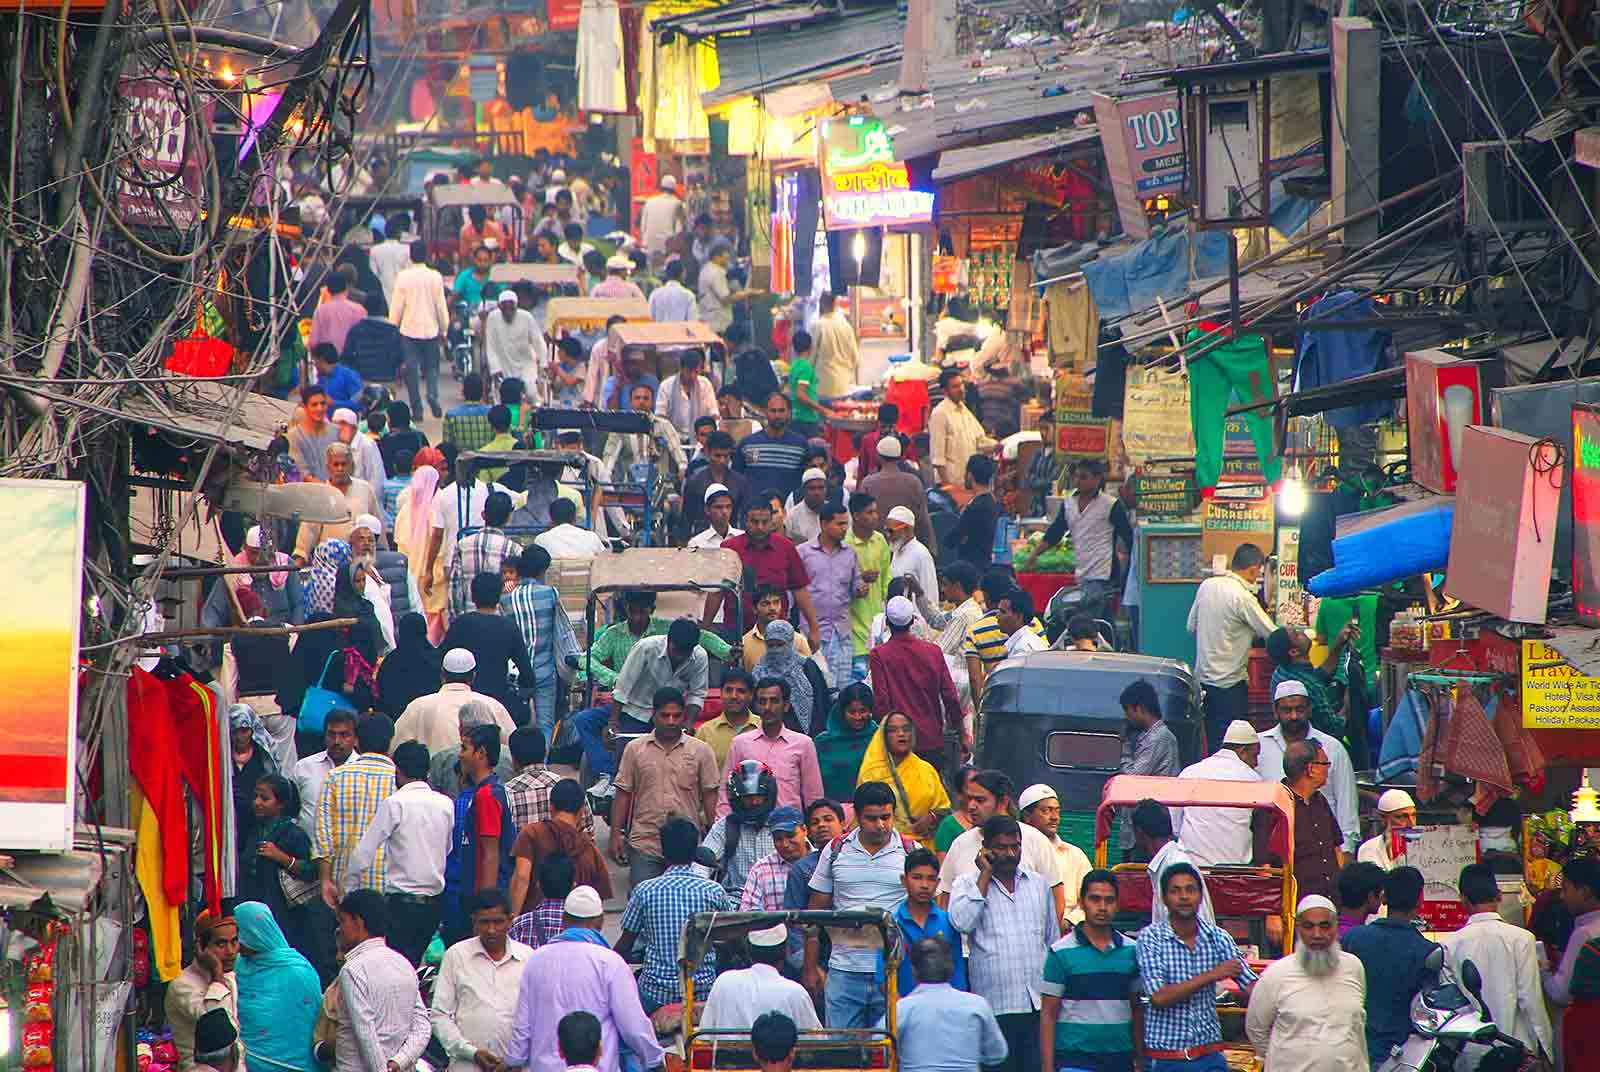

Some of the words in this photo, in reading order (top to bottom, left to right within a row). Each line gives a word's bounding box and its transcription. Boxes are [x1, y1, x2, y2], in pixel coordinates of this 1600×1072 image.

[1127, 109, 1178, 149] TOP
[1207, 503, 1267, 519] CURRENCY
[1526, 681, 1550, 689] World
